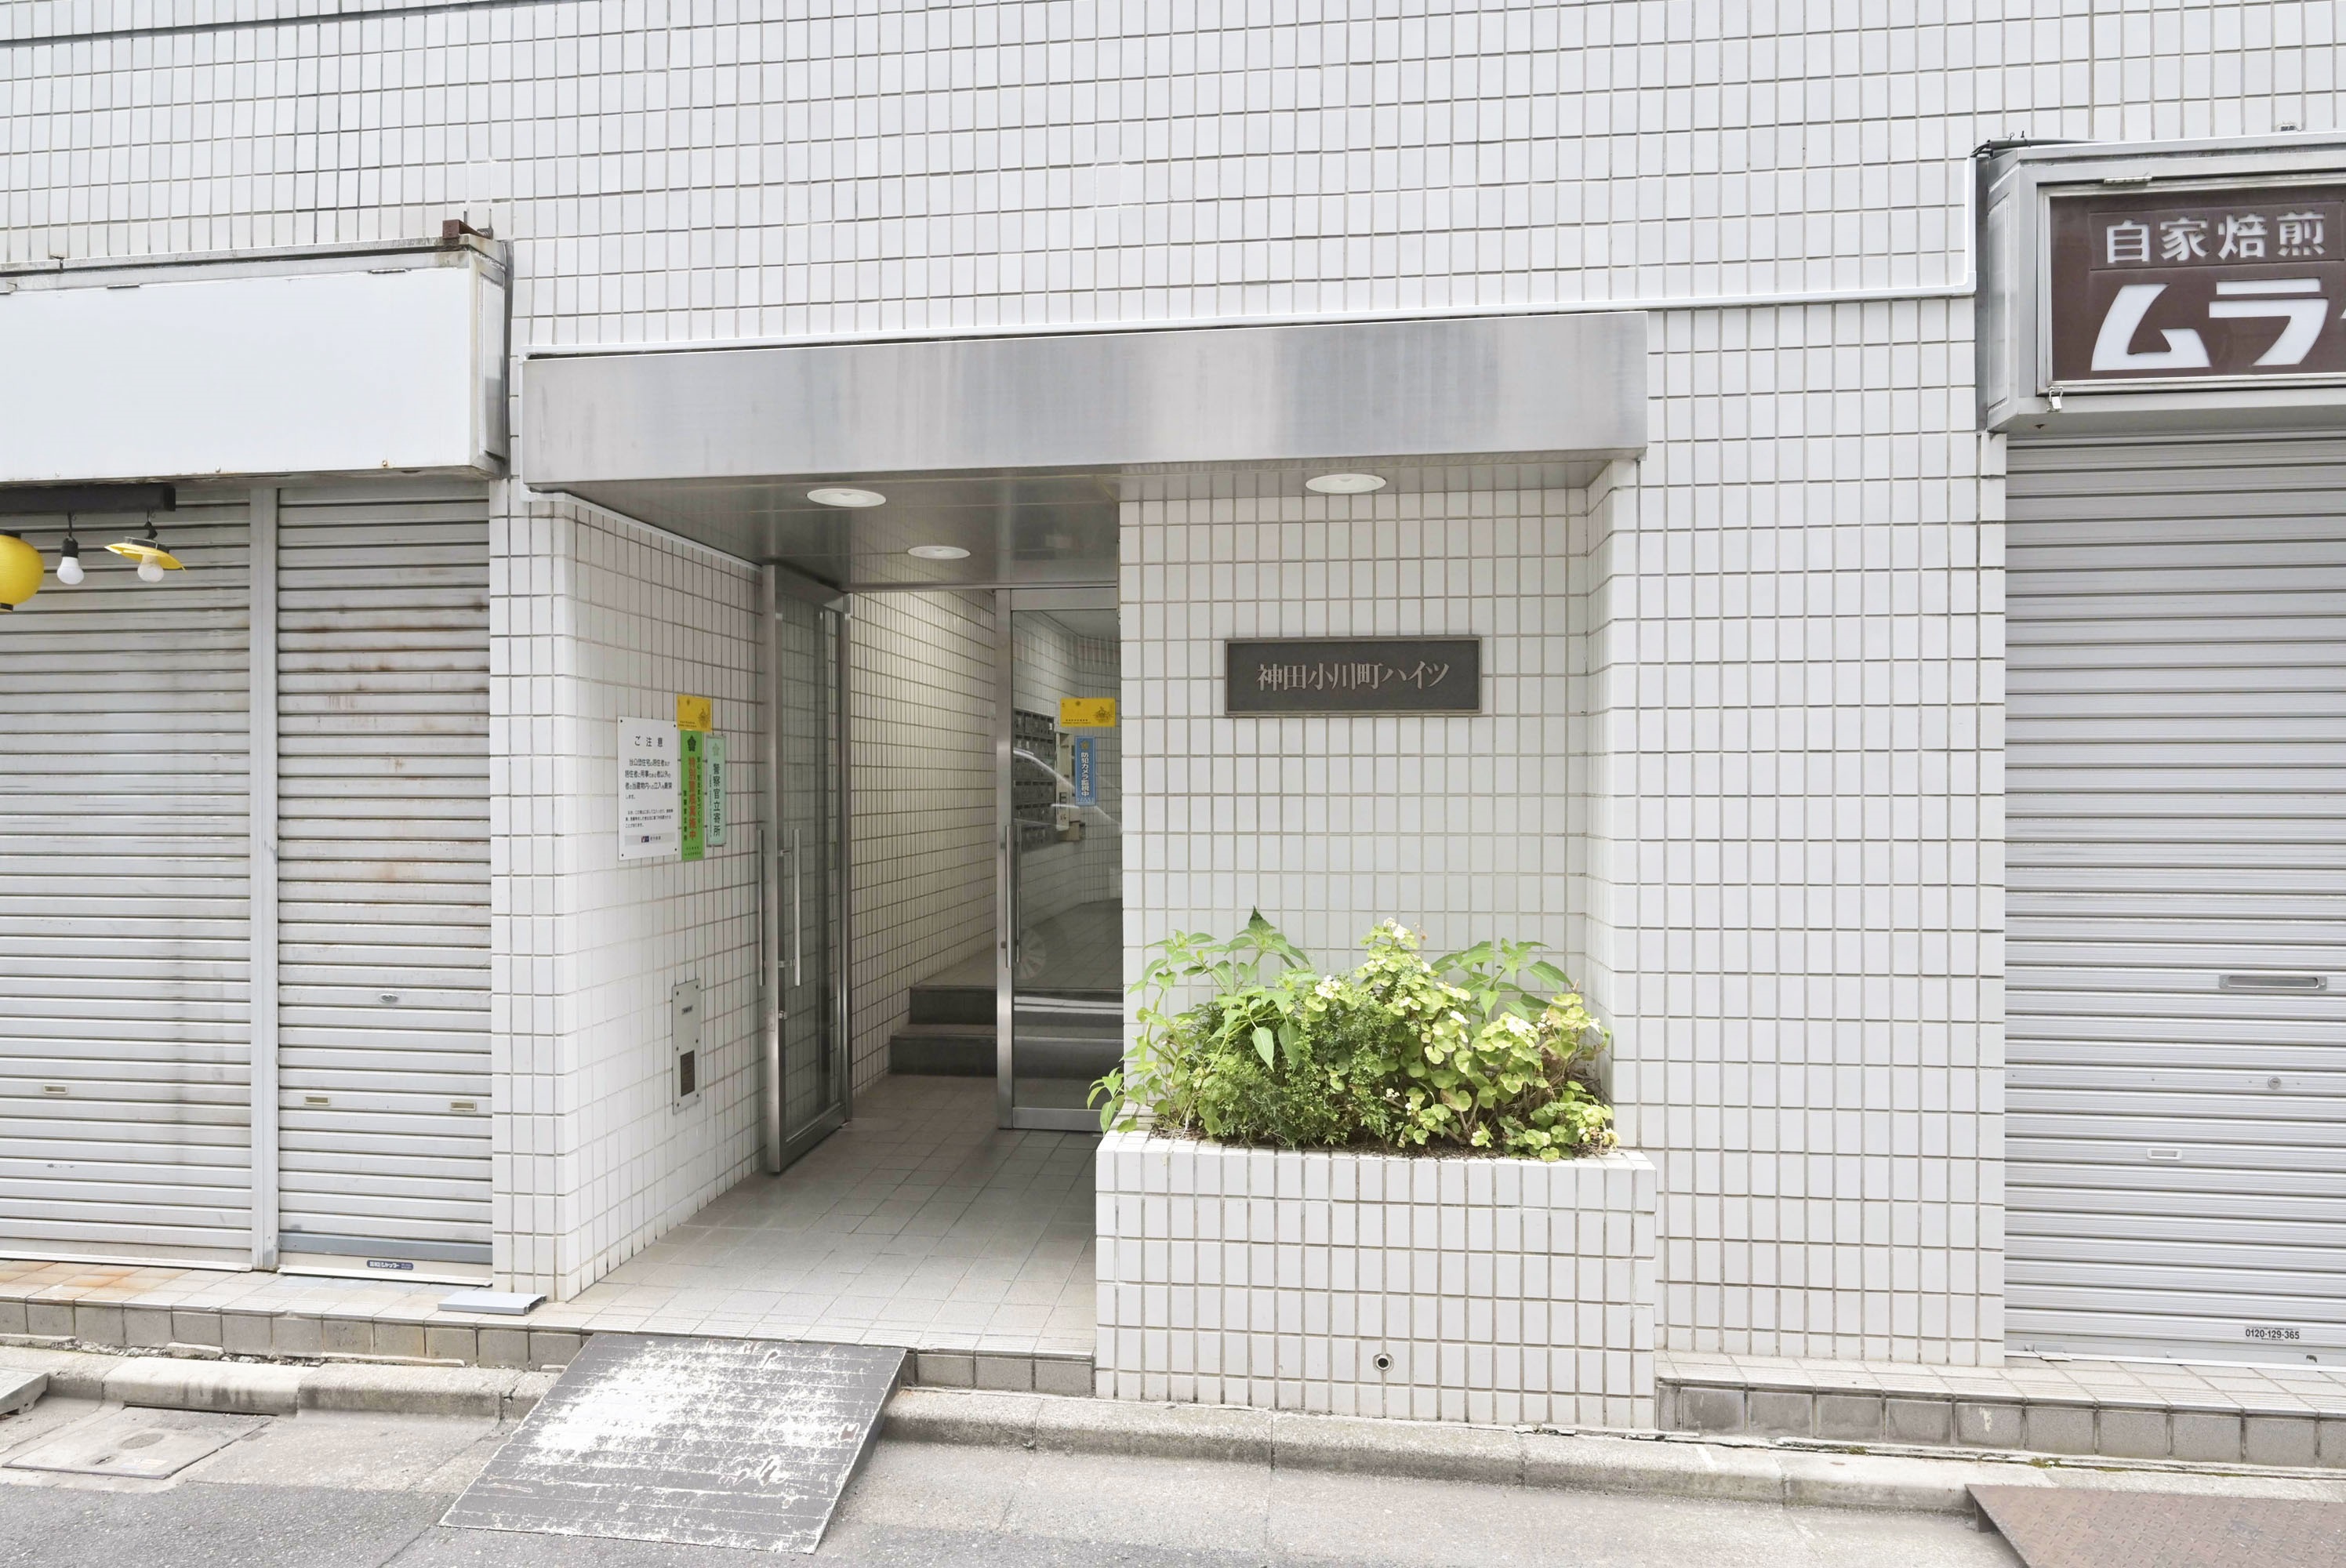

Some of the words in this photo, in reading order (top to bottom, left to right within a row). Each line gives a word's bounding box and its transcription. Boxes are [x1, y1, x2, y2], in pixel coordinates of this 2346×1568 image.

[2105, 209, 2326, 264] 自家焙煎
[2091, 277, 2346, 372] ムラ
[1255, 661, 1450, 691] 神田小川町ハイツ
[634, 735, 663, 747] ご注意
[1080, 752, 1089, 797] 防犯カメラ監視中
[2246, 1329, 2300, 1339] 0120-129-365
